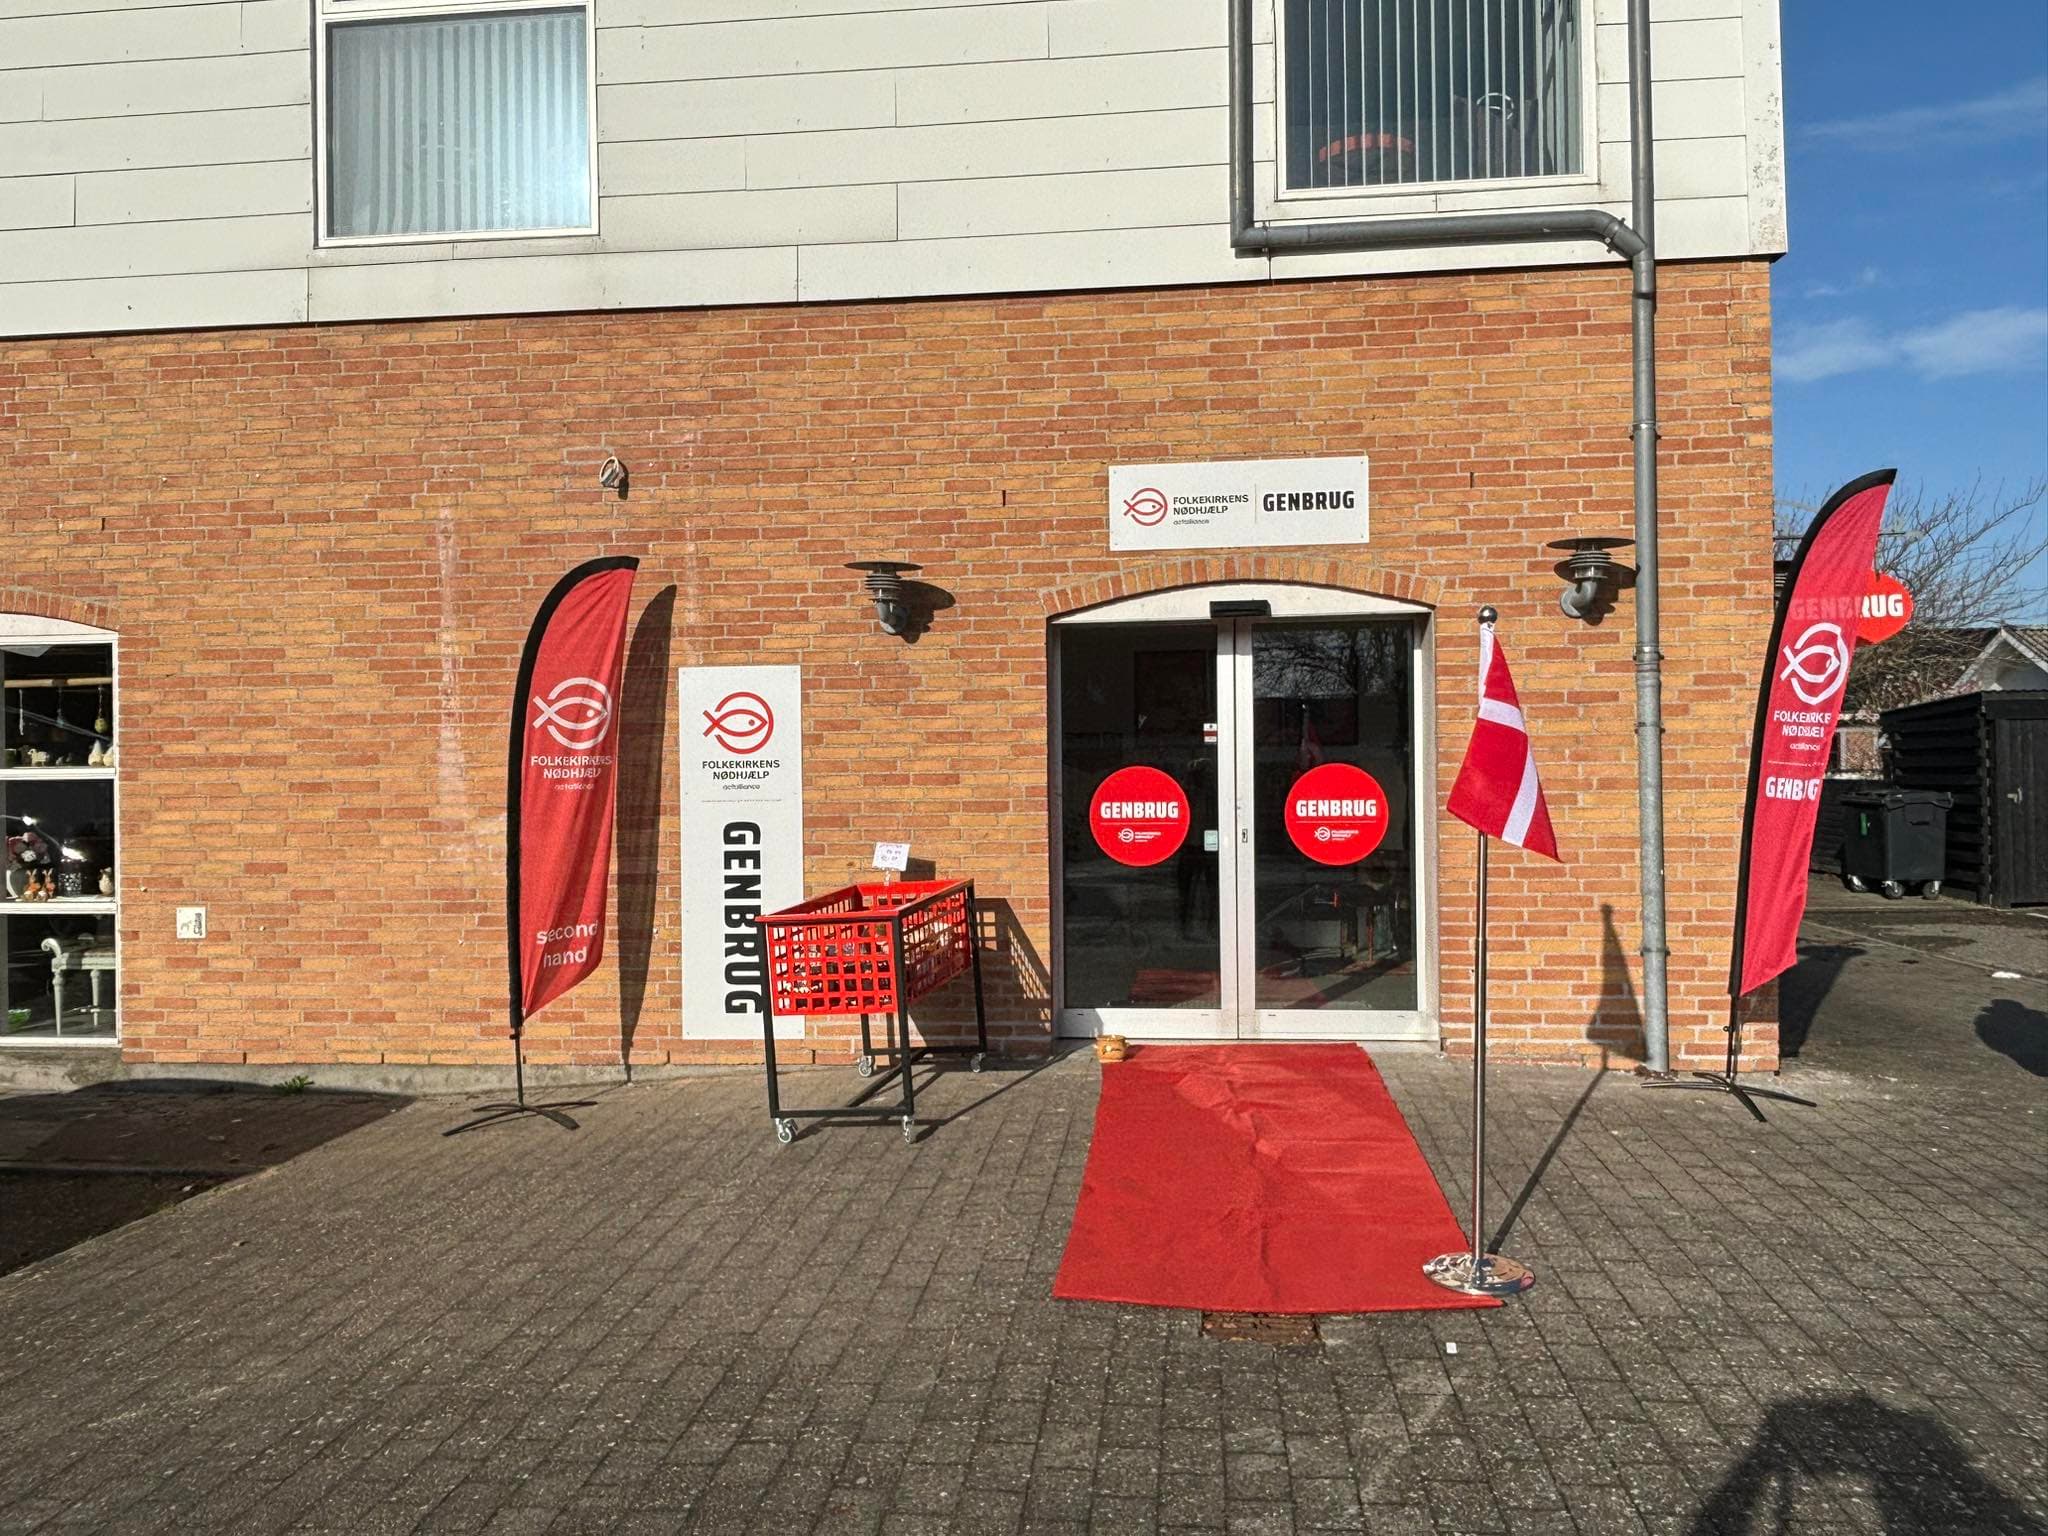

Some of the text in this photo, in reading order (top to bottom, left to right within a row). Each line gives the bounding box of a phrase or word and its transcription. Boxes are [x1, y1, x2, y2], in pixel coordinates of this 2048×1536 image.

[1173, 494, 1249, 505] FOLKEKIRKENS
[1263, 491, 1355, 512] GENBRUG
[1173, 505, 1228, 515] NØDHJÆLP
[702, 759, 781, 770] FOLKEKIRKENS
[712, 770, 770, 780] NØDHJÆLP
[1100, 801, 1179, 819] GENBRUG
[1296, 799, 1377, 817] GENBRUG
[723, 821, 763, 1014] GENBRUG
[536, 920, 599, 945] second
[543, 946, 588, 968] hand
